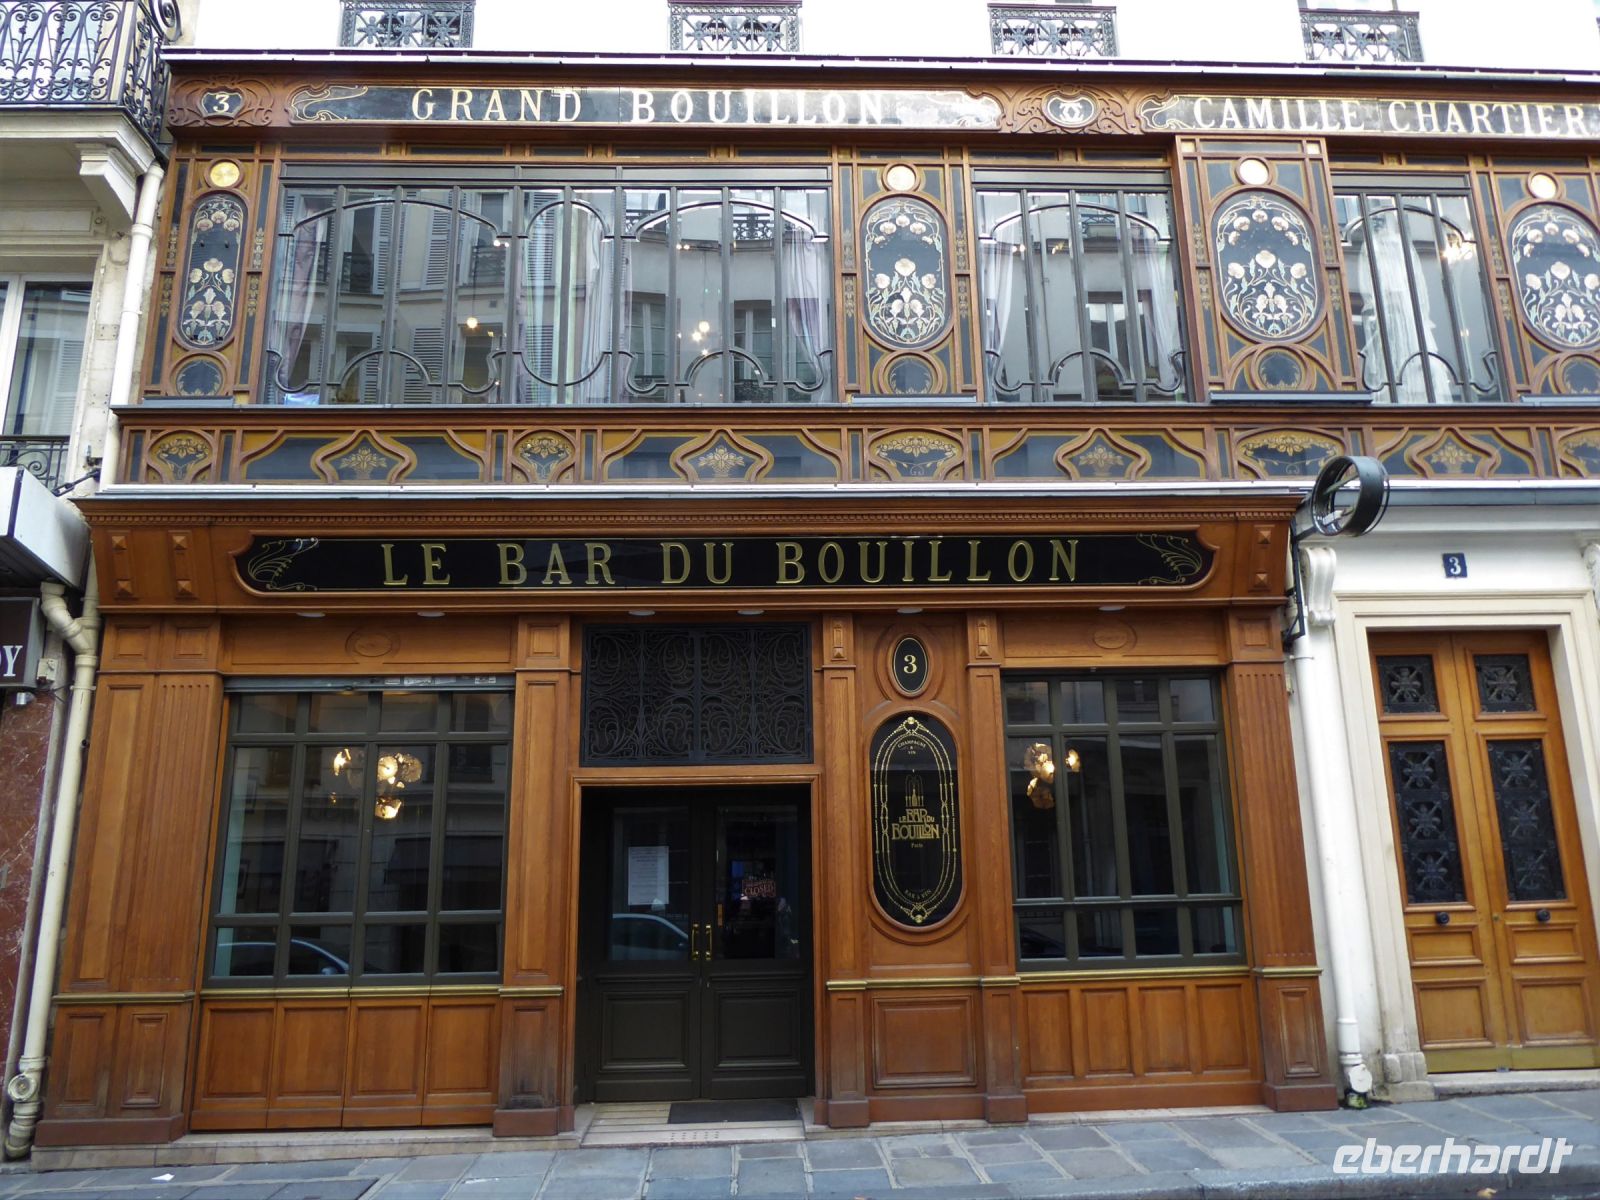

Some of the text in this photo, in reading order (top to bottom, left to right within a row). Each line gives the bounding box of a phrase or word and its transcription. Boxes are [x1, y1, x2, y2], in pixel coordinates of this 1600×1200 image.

[212, 91, 230, 113] 3
[412, 87, 886, 124] GRAND BOUILLON
[1193, 96, 1589, 137] CAMILLE CHARTIER
[381, 539, 1079, 586] LE BAR DU BOUILLON
[1449, 556, 1462, 575] 3
[0, 645, 23, 677] Y
[904, 655, 917, 674] 3
[906, 808, 927, 823] BAR
[926, 815, 935, 823] DU
[891, 823, 940, 840] BOUILLON
